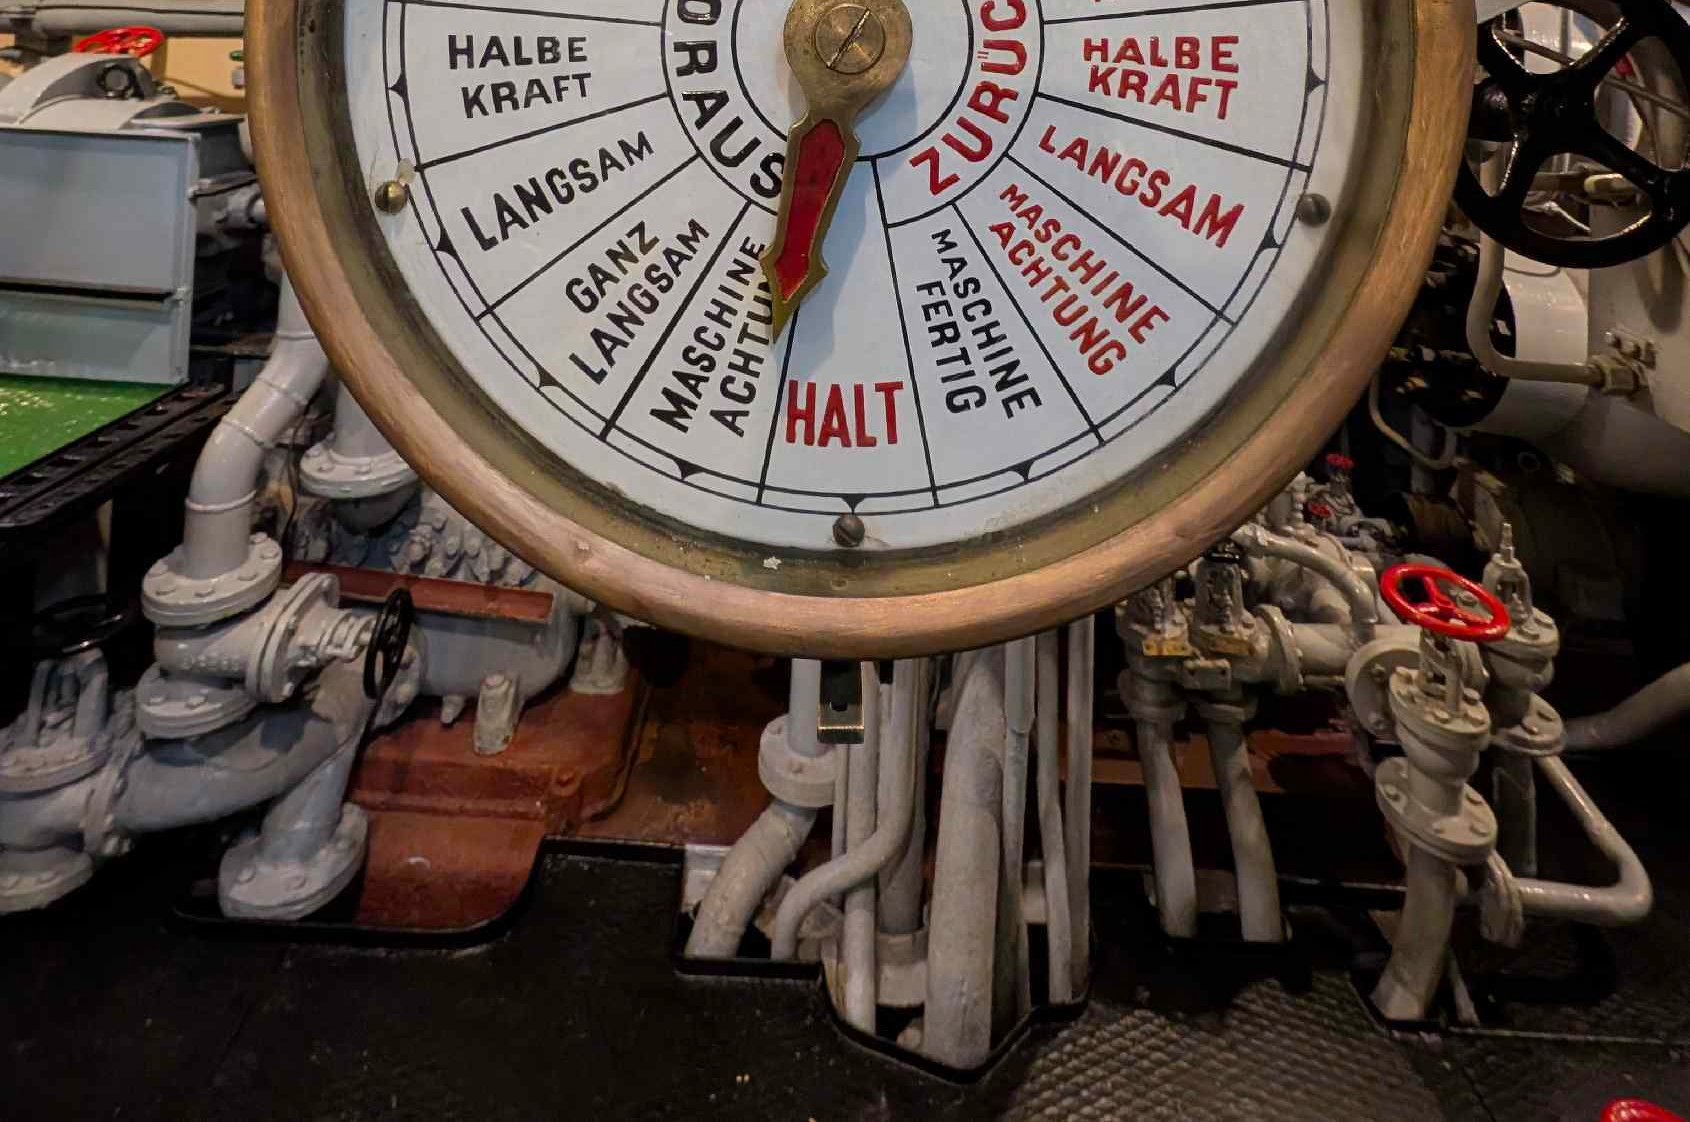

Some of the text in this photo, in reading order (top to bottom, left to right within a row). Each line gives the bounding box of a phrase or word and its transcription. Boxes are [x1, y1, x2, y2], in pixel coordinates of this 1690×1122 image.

[448, 34, 588, 69] HALBE
[461, 73, 591, 118] KRAFT
[1083, 35, 1239, 73] HALBE
[1088, 64, 1238, 120] KRAFT
[460, 131, 654, 251] LANGSAM
[1038, 125, 1245, 248] LANGSAM
[565, 220, 660, 313] GANZ
[568, 218, 710, 385] LANGSAM
[931, 228, 1043, 419] MASCHINE
[988, 221, 1128, 376] ACHTUNG
[999, 183, 1170, 345] MASCHINE
[649, 236, 766, 433] MASCHINE
[709, 281, 773, 438] ACHTU
[916, 280, 987, 414] FERTIG
[785, 380, 904, 448] HALT
